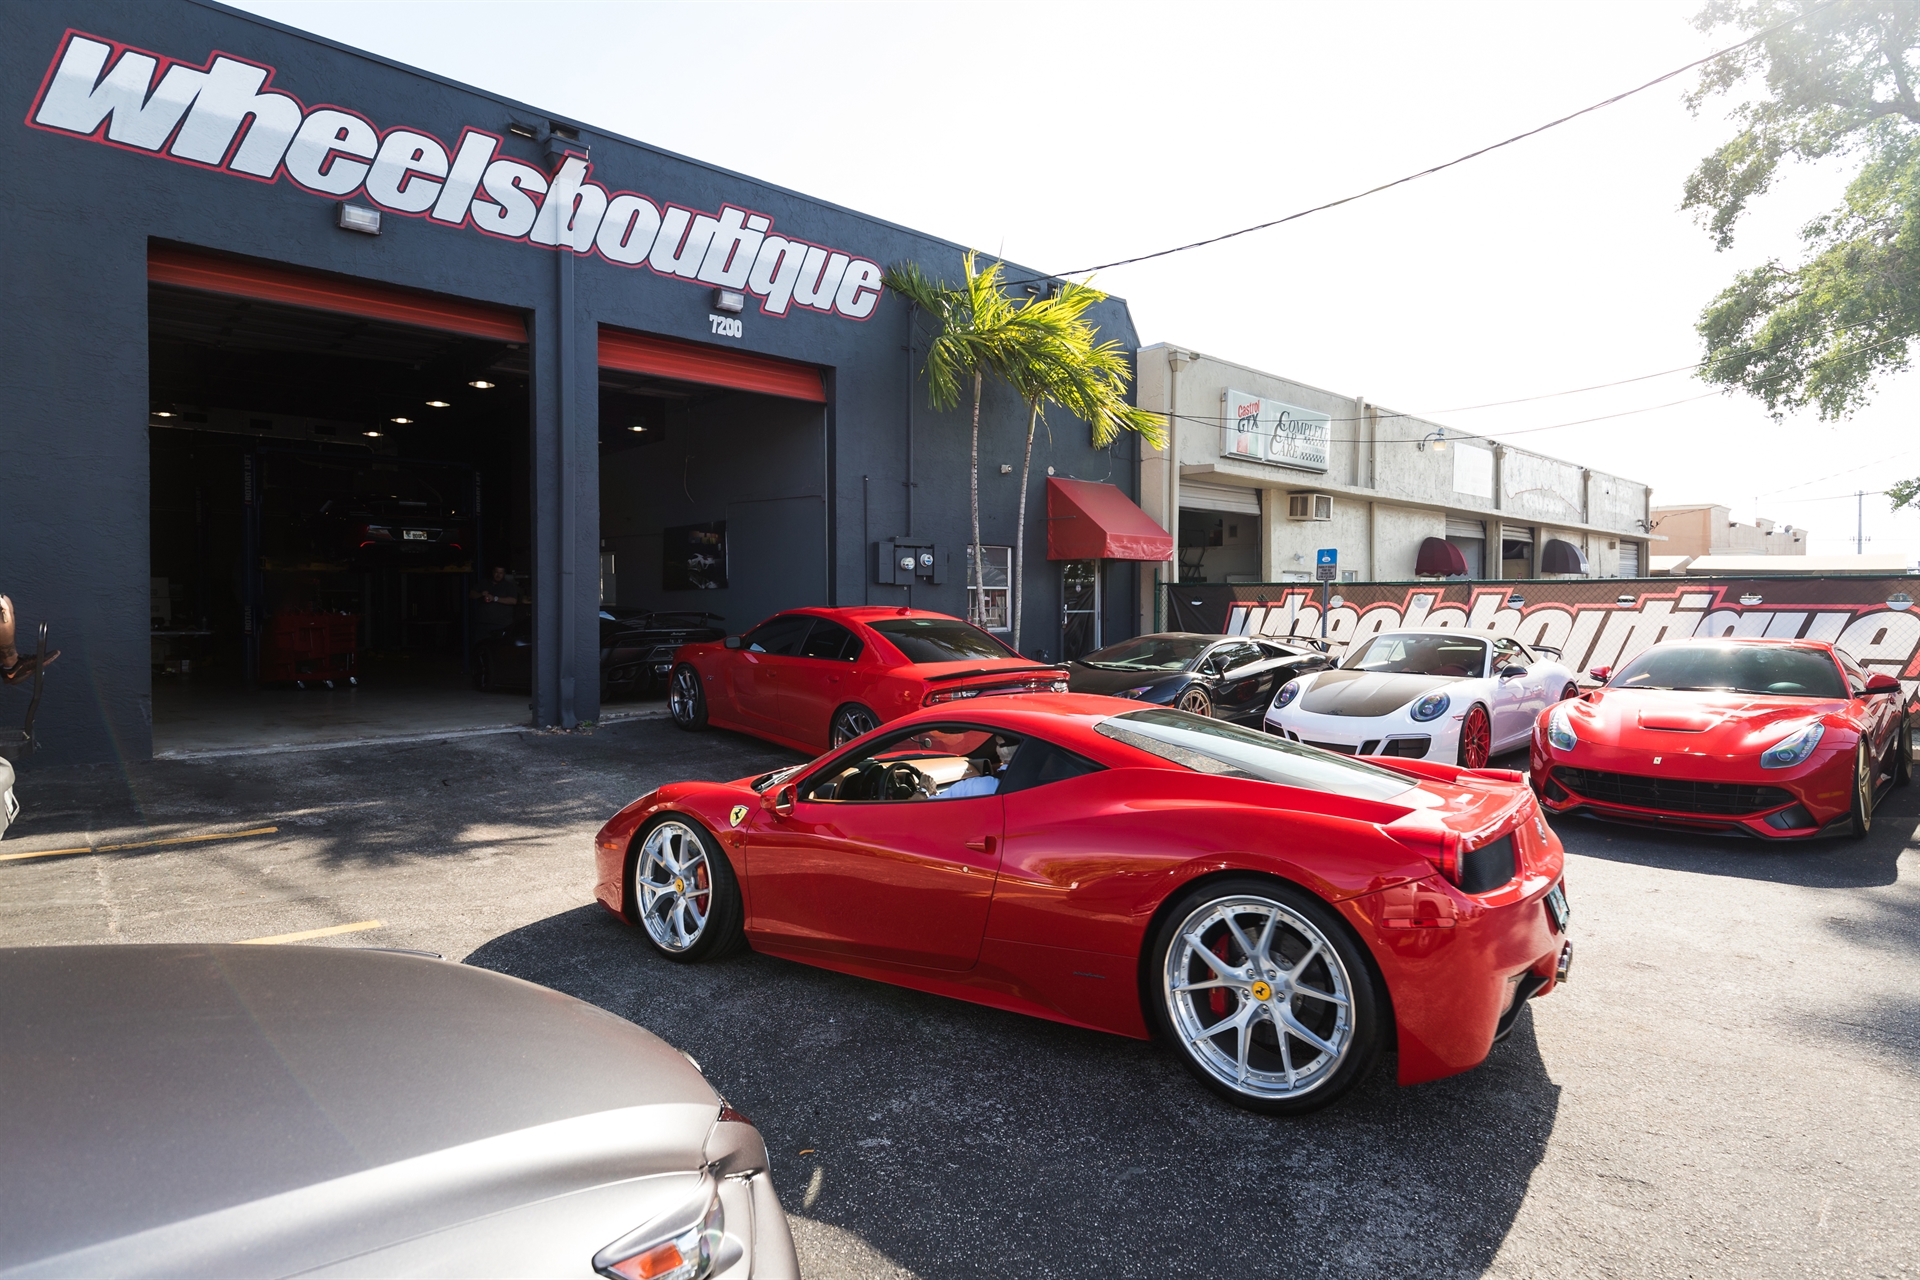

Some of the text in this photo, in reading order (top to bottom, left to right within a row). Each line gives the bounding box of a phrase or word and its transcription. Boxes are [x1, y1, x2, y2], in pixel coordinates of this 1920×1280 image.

[29, 31, 885, 319] wheelsboutique
[709, 313, 743, 338] 7200
[1237, 399, 1260, 418] Castrol
[1237, 412, 1259, 433] GTX
[244, 453, 252, 501] ROTARY LIFT
[244, 605, 252, 631] ROTAR
[1225, 593, 1919, 688] wheeoutie
